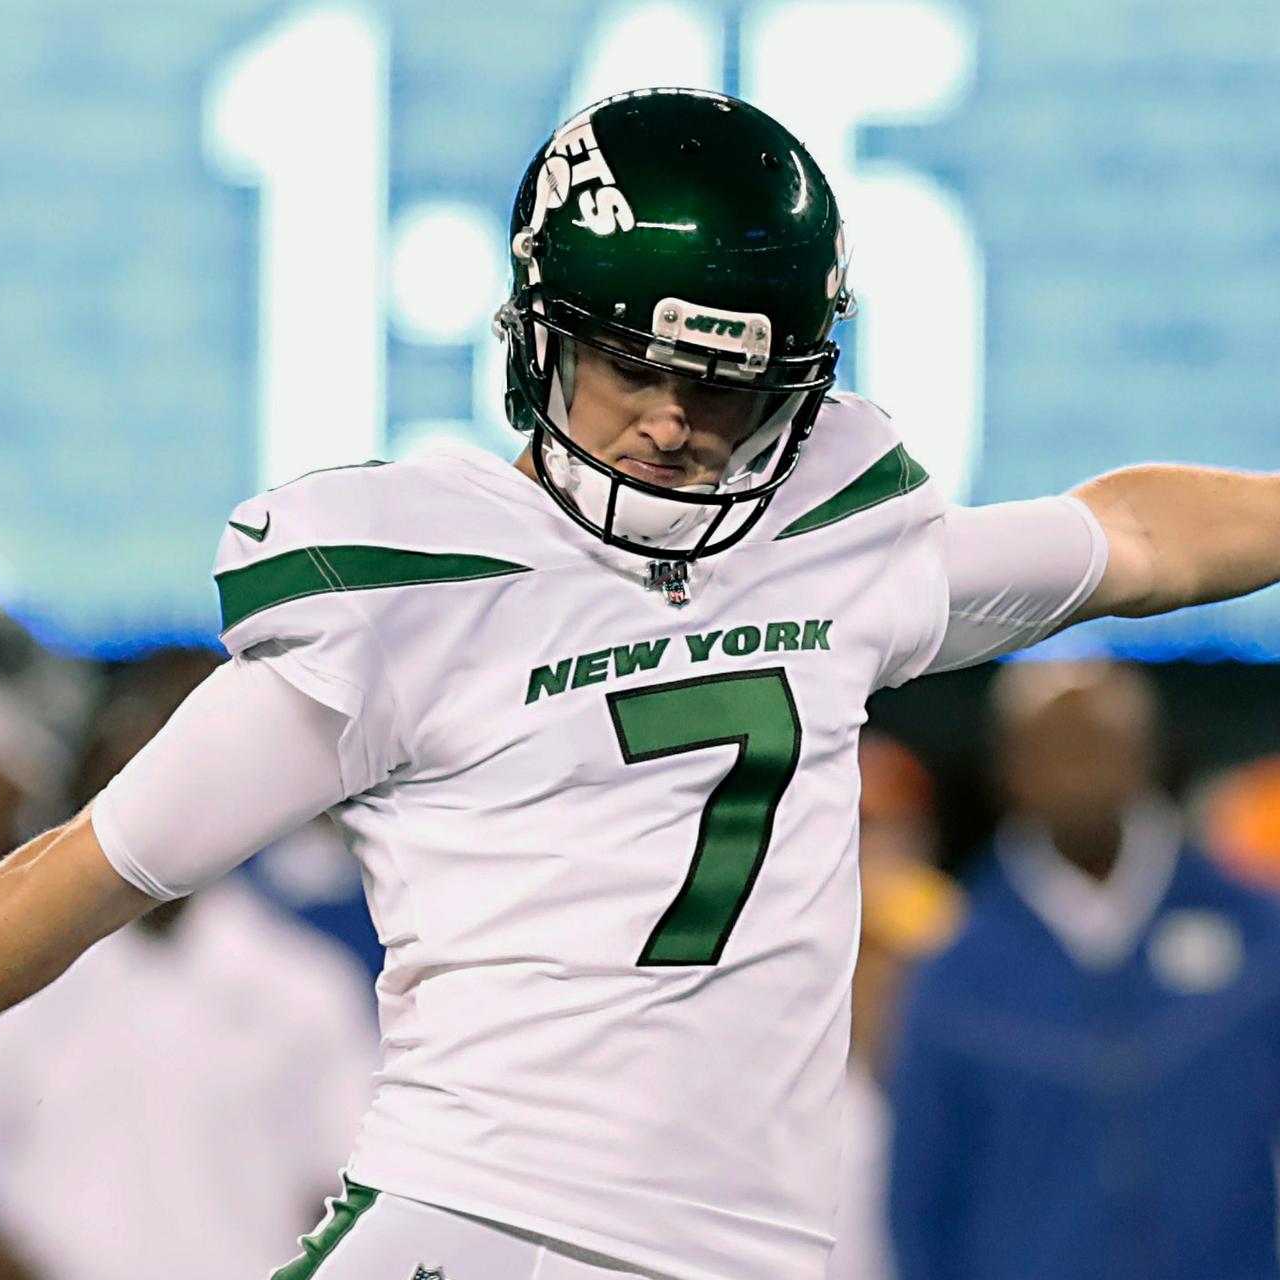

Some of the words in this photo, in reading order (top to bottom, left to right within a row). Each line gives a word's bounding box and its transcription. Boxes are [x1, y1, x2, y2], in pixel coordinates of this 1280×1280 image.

[684, 314, 747, 339] JETS
[525, 638, 671, 706] NEW
[685, 619, 833, 664] YORK
[605, 666, 802, 967] 7
